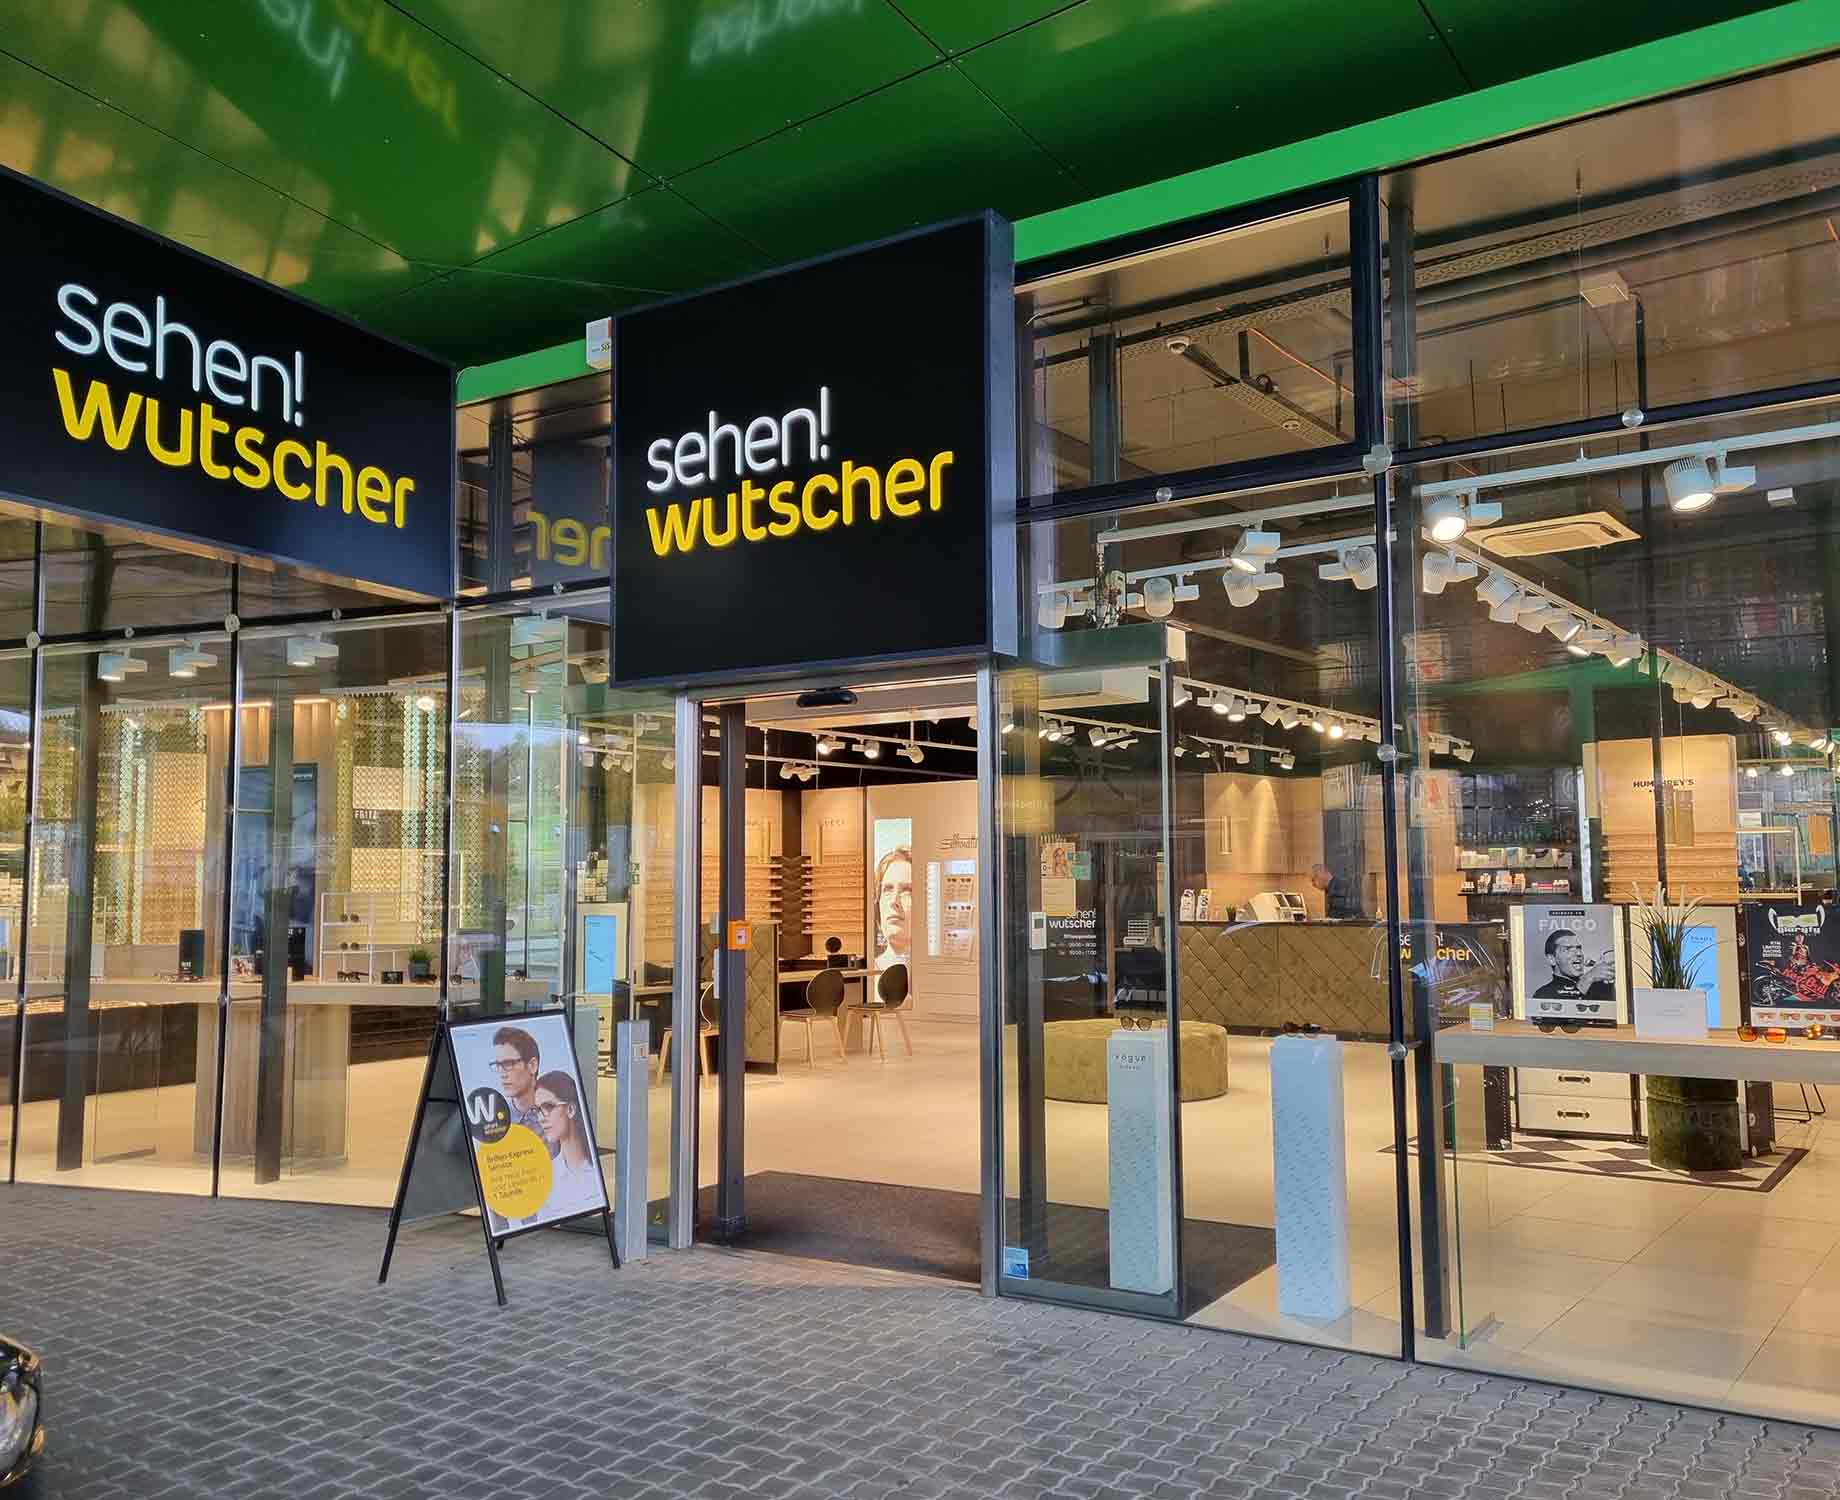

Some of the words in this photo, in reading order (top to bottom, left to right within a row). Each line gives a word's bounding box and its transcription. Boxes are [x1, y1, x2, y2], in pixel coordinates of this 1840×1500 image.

[55, 283, 305, 428] sehen!
[52, 368, 415, 529] wutscher
[646, 386, 832, 492] sehen!
[646, 451, 954, 558] wutscher
[1048, 918, 1097, 929] wutscher
